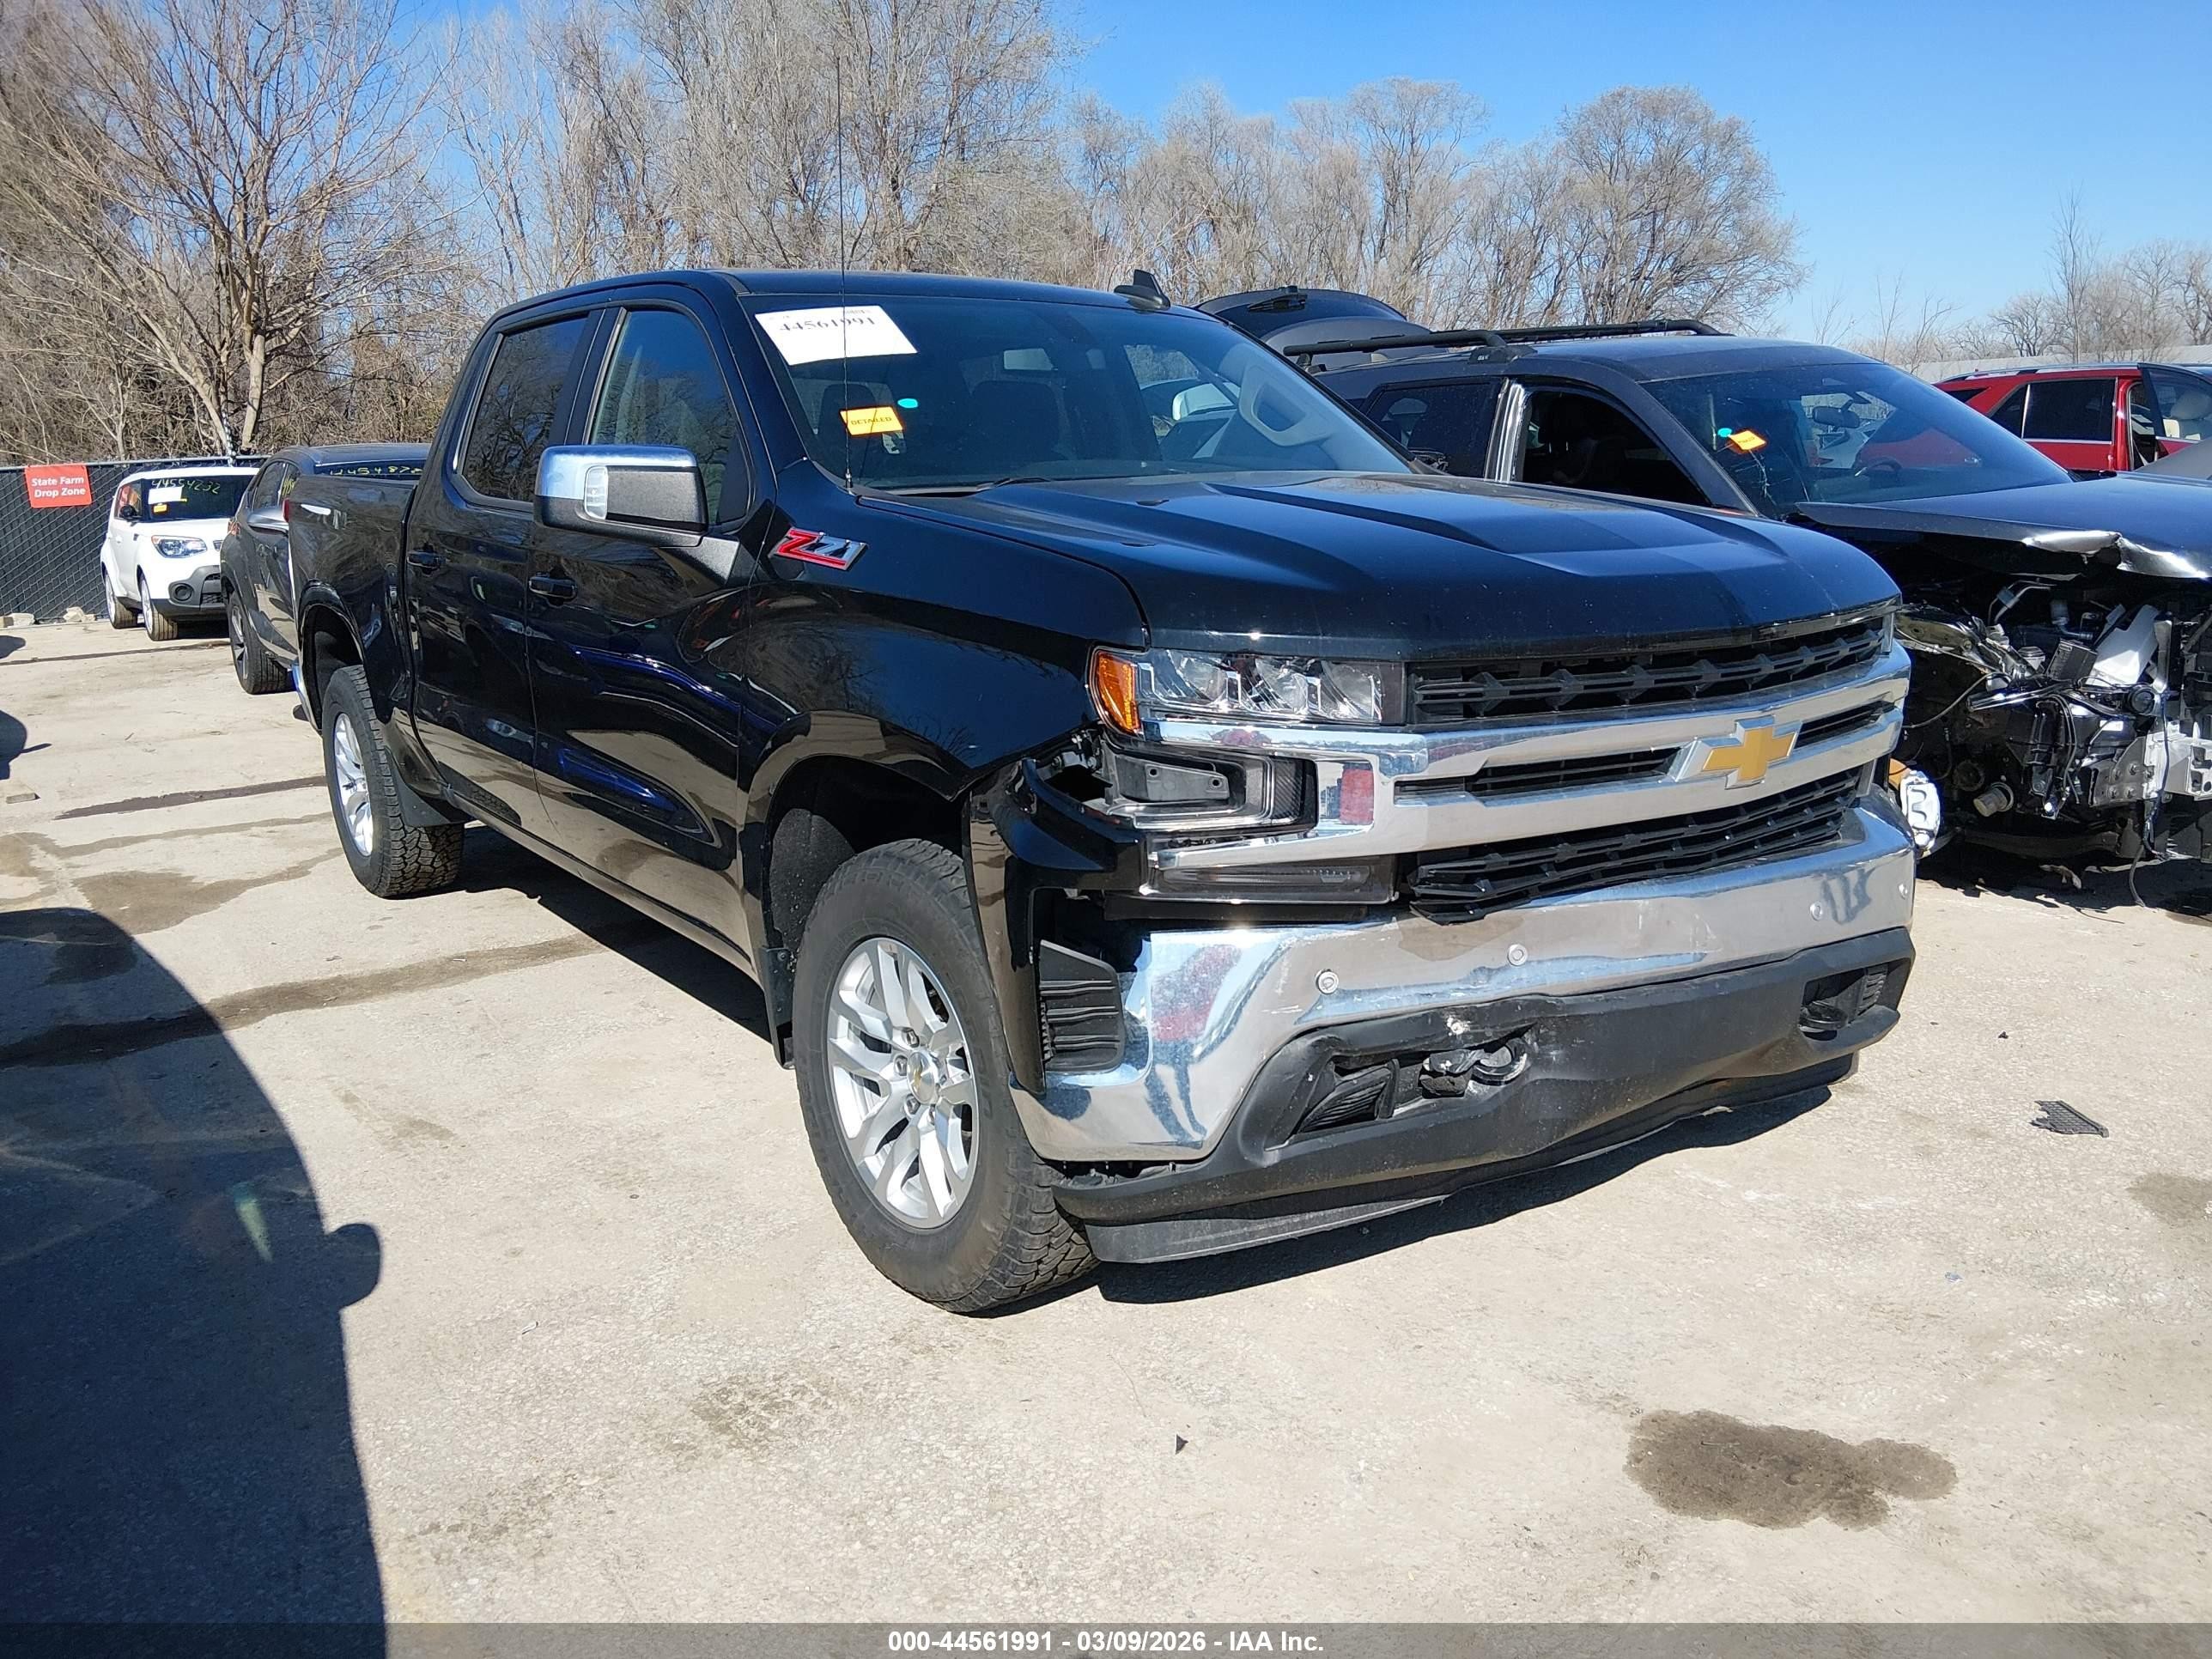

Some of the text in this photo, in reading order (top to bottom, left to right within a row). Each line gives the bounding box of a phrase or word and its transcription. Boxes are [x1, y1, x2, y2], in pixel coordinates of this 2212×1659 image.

[850, 416, 892, 426] DETAILED
[31, 476, 84, 487] State Farm
[34, 487, 86, 499] Drop Zone
[771, 526, 867, 571] Z71
